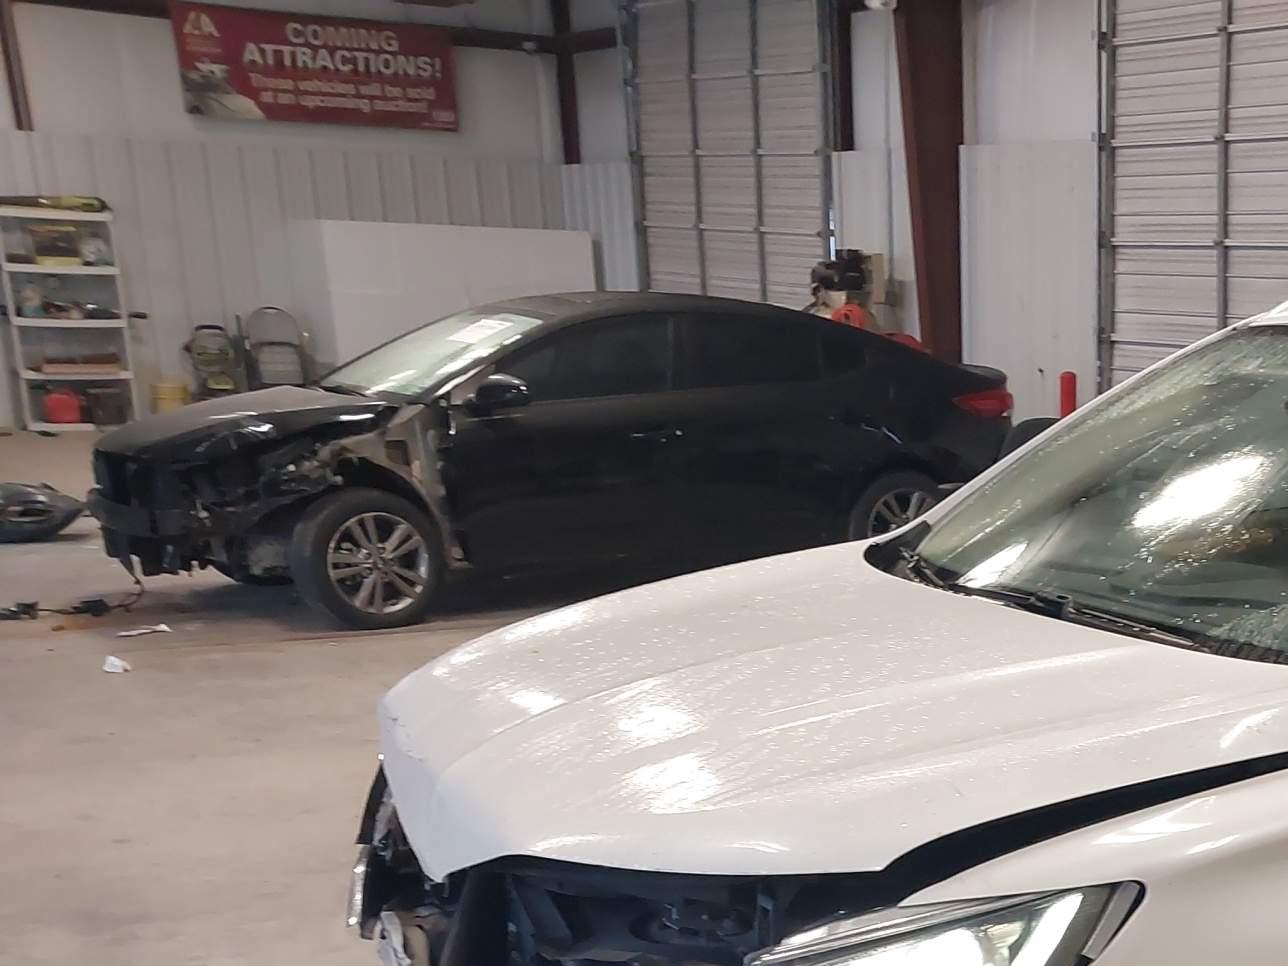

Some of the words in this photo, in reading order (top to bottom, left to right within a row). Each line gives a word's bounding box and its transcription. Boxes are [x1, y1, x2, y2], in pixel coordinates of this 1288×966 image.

[285, 22, 399, 50] COMING
[242, 42, 442, 78] ATTRACTIONS!
[299, 79, 356, 94] vehicles
[358, 83, 382, 96] will
[384, 84, 402, 98] be
[405, 86, 435, 99] sold
[299, 95, 371, 112] upcoming
